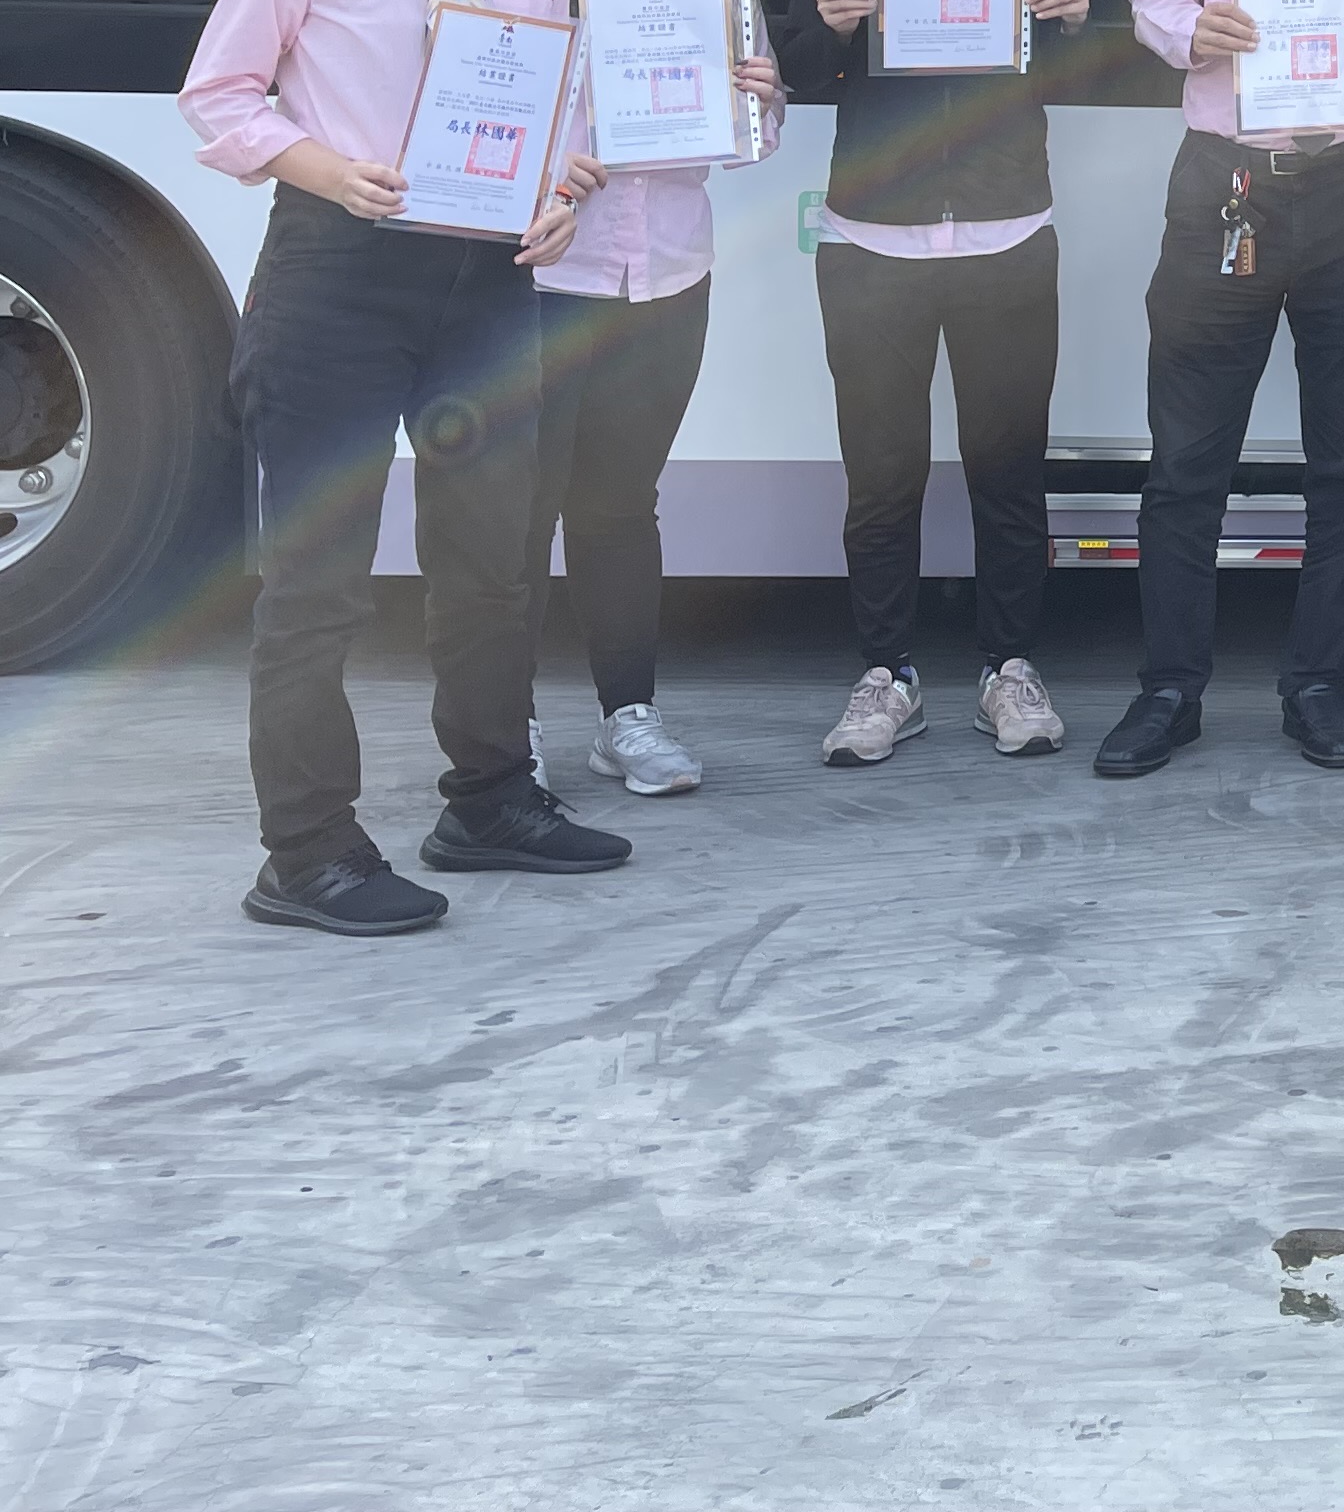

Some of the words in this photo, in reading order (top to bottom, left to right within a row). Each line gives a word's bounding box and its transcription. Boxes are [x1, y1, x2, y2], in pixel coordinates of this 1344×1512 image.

[446, 119, 519, 142] 局長林國華
